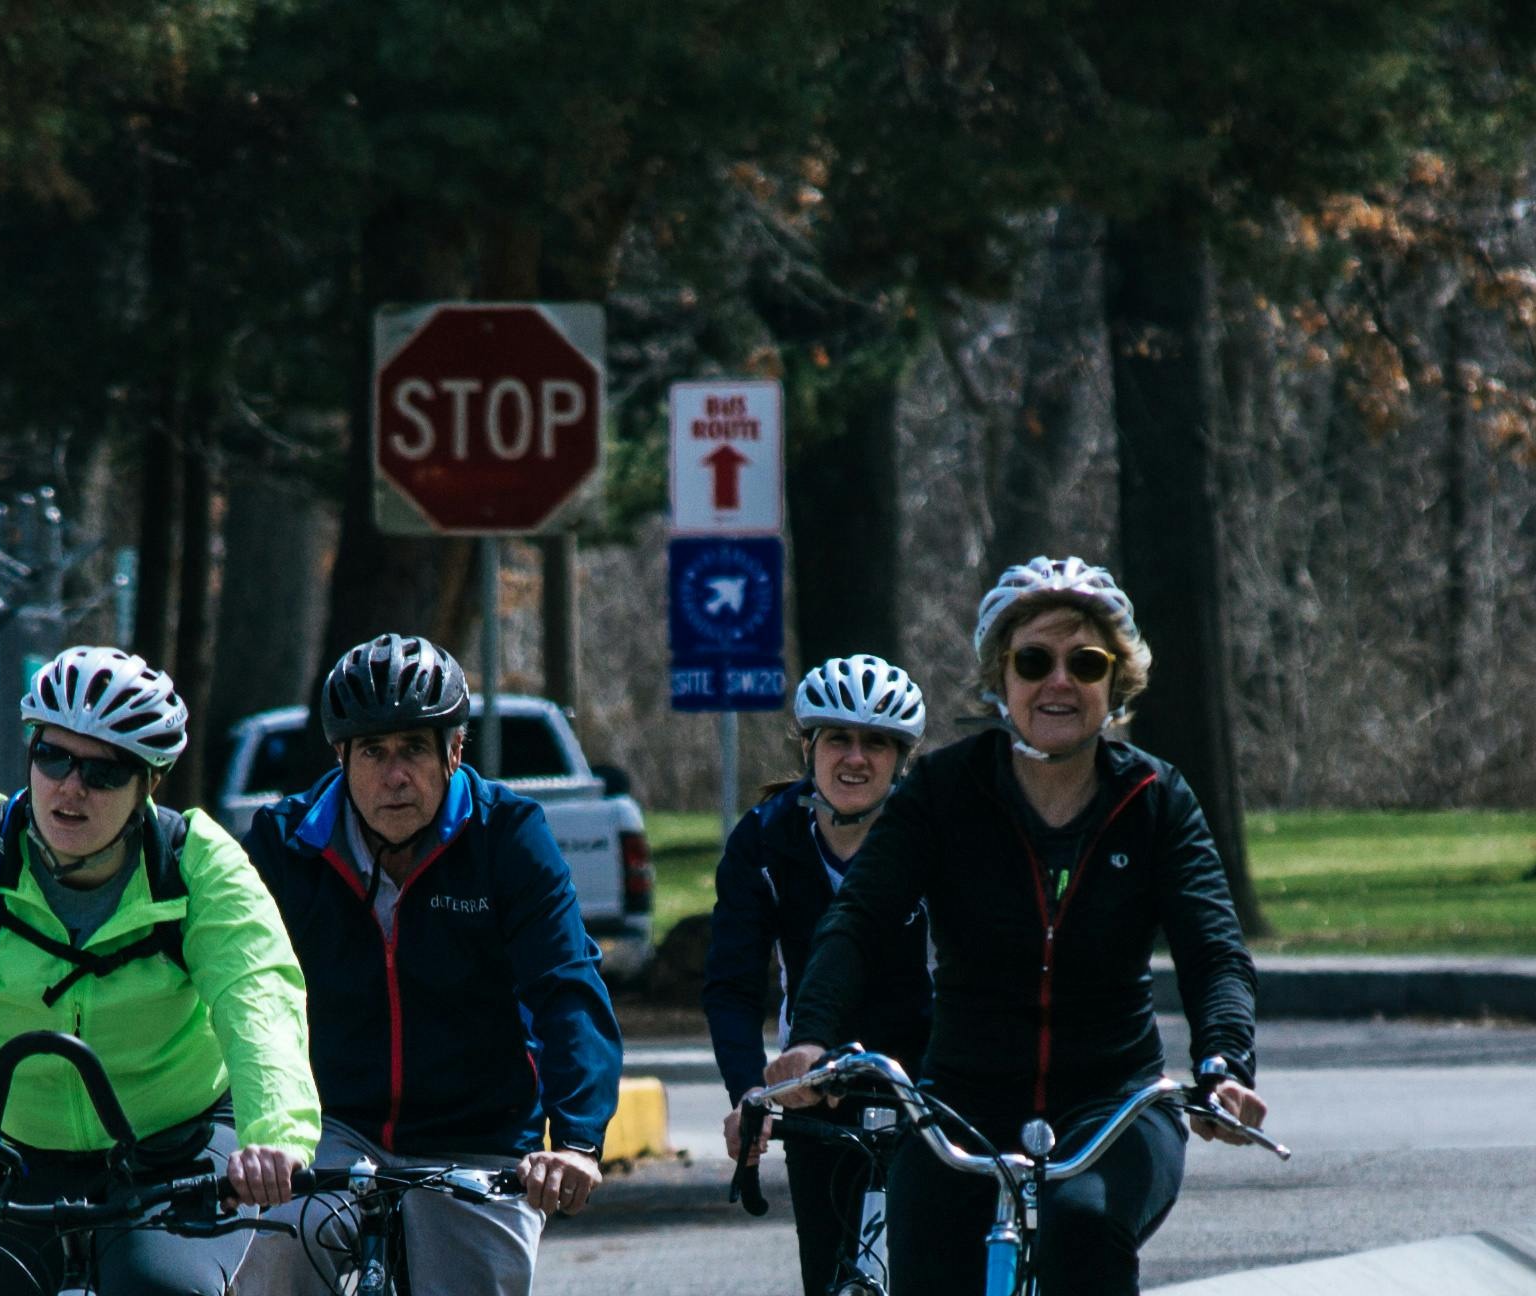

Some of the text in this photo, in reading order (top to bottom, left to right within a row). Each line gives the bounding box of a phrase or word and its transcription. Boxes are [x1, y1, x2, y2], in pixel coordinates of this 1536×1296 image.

[706, 395, 747, 417] BUS
[390, 378, 587, 460] STOP
[691, 419, 760, 440] ROUTE
